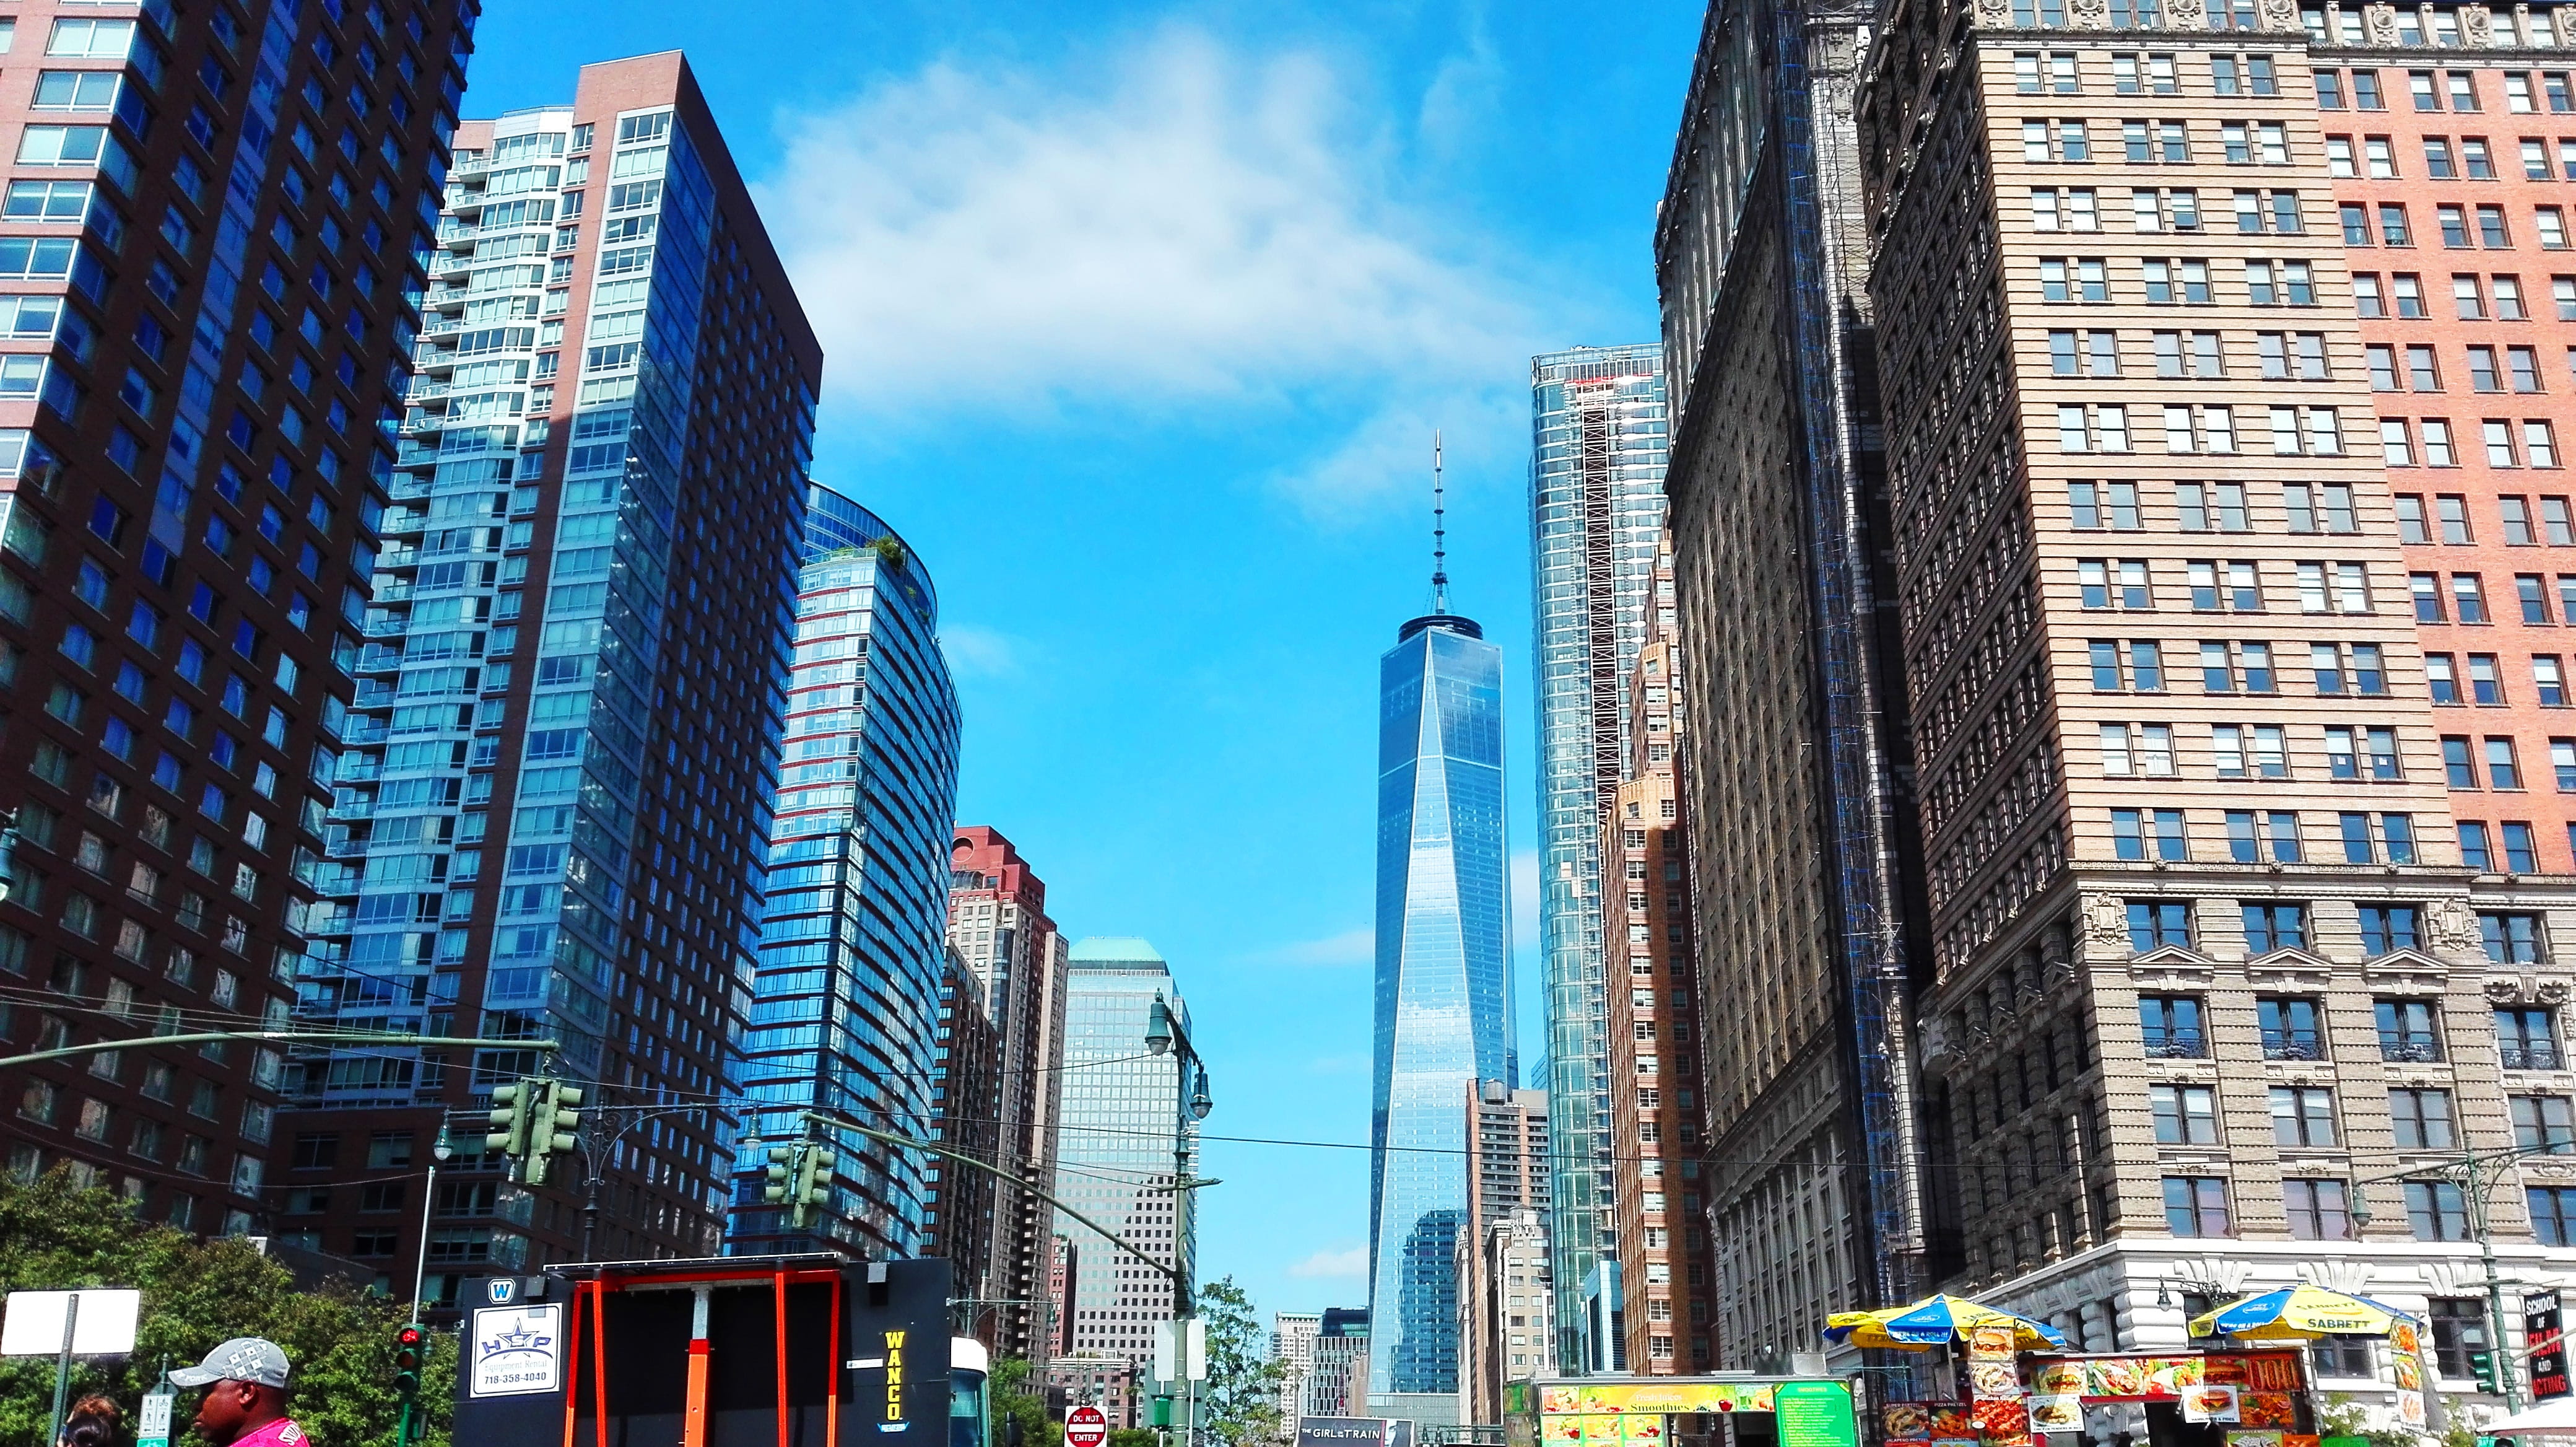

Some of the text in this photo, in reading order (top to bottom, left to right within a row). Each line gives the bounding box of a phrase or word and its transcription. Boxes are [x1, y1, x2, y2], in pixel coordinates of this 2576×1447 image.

[494, 1284, 510, 1298] W
[2526, 1295, 2557, 1316] SCHOOL
[2307, 1319, 2370, 1329] SABRETT
[2537, 1316, 2546, 1329] OF
[485, 1360, 547, 1373] Equipment Rental
[2538, 1360, 2552, 1373] AND
[485, 1372, 546, 1384] 718-358-4040
[885, 1331, 905, 1420] WANCO
[1659, 1394, 1682, 1402] Juices
[1630, 1402, 1690, 1412] Smoothies
[1313, 1428, 1337, 1438] GIRL
[1344, 1429, 1380, 1440] TRAIN
